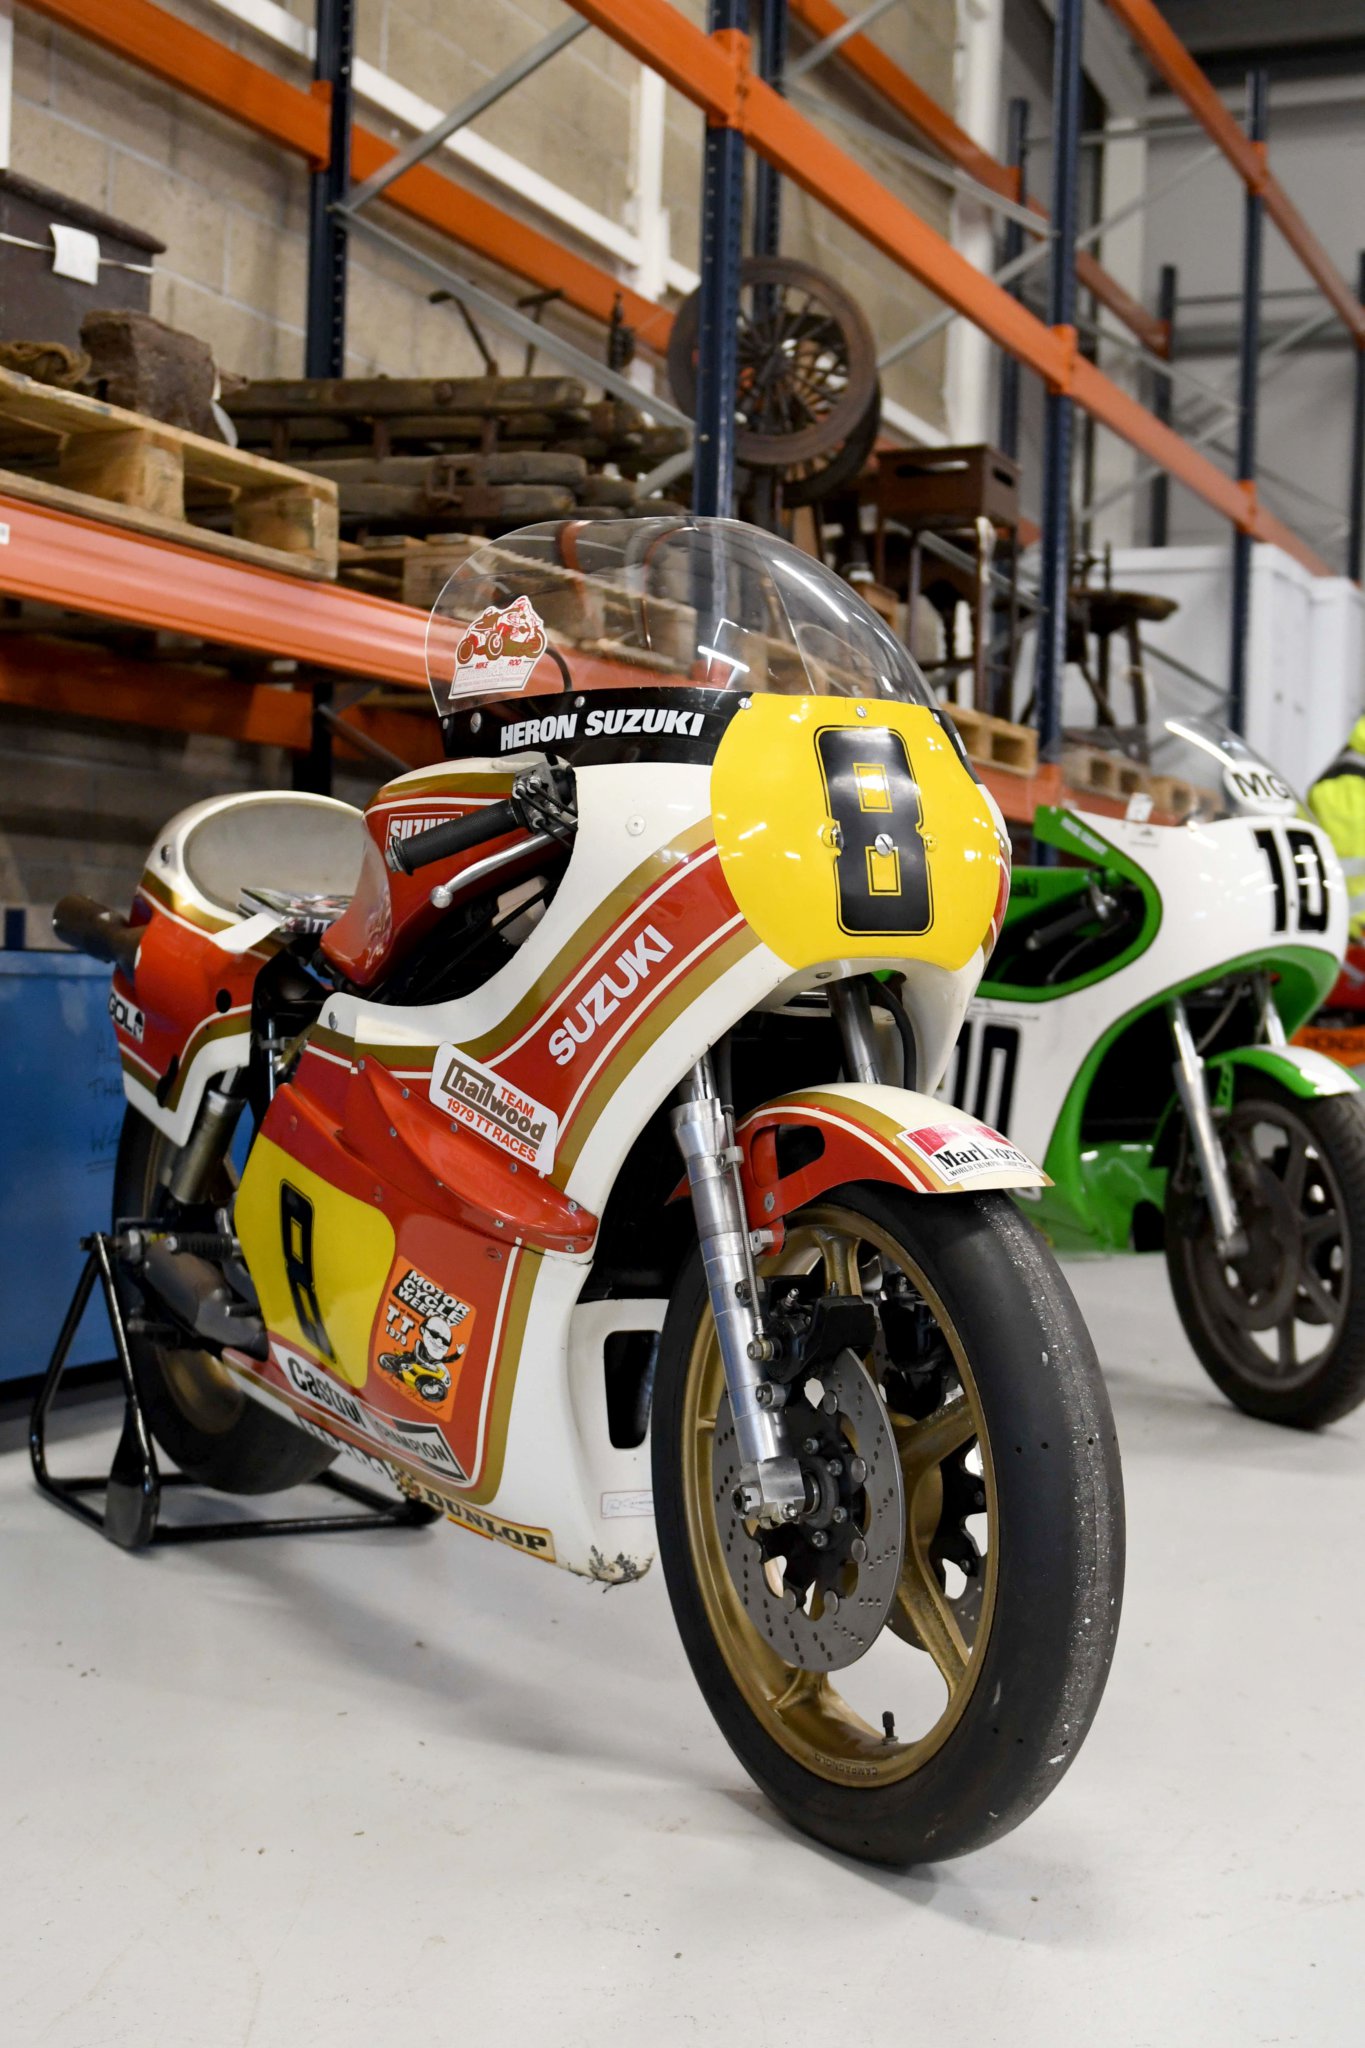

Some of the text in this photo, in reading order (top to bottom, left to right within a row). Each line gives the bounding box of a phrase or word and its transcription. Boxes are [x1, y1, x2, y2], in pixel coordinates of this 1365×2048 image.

[501, 709, 705, 751] HERON SUZUKI
[1232, 772, 1291, 799] MG
[814, 725, 934, 936] 8
[1252, 828, 1330, 933] 10
[548, 924, 674, 1066] SUZUKI
[446, 1098, 537, 1162] 1979 TT RACES
[451, 1064, 548, 1142] hailwood
[500, 1086, 536, 1118] TEAM
[949, 1165, 974, 1177] WORLD
[279, 1178, 337, 1364] 8
[402, 1278, 465, 1325] CYCLE
[408, 1270, 471, 1317] MOTOR
[287, 1357, 367, 1429] Castrol
[424, 1487, 547, 1551] DUNLOP
